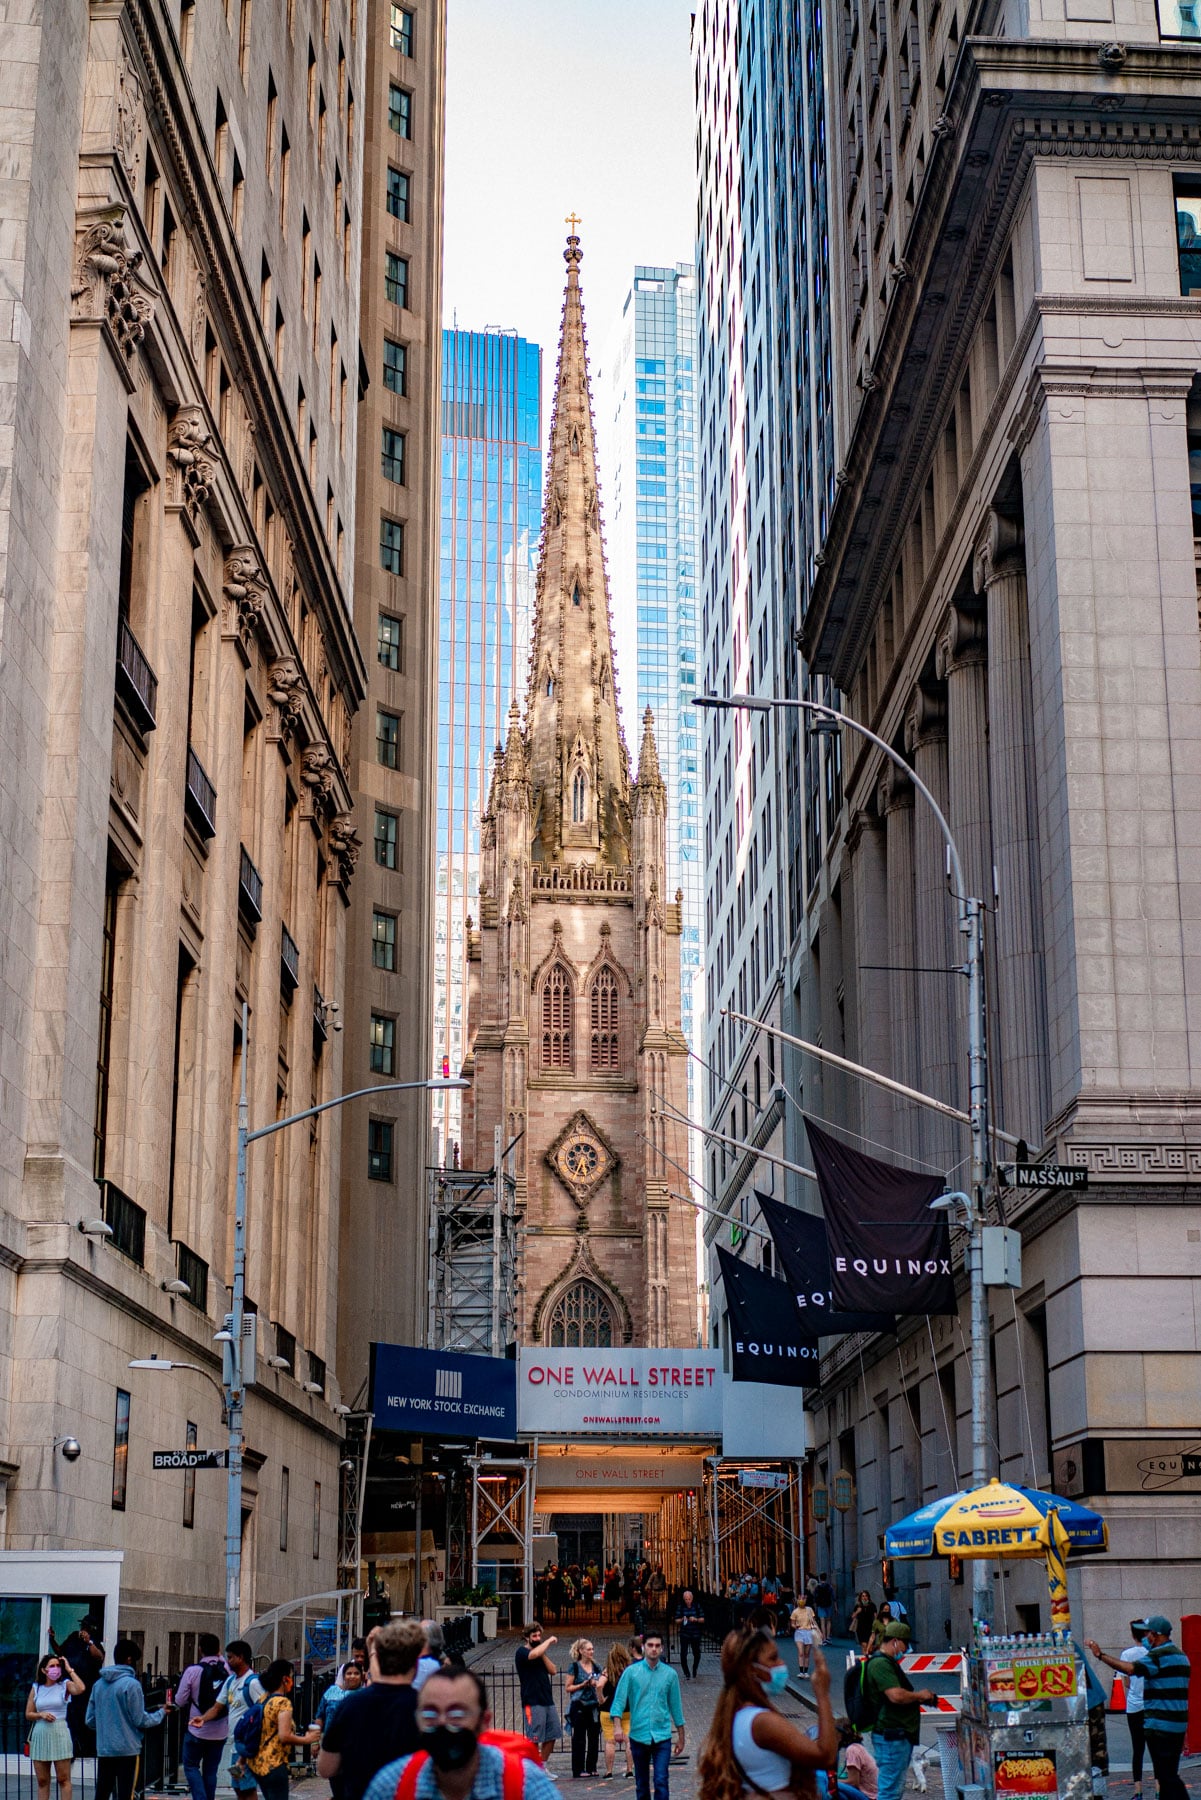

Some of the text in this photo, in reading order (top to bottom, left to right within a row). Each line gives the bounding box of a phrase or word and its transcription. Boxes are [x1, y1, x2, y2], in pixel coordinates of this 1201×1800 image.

[1019, 1169, 1085, 1186] NASSAU ST
[836, 1257, 951, 1276] EQUINOX
[736, 1342, 818, 1360] EQUINOX
[528, 1366, 716, 1386] ONE WALL STREET
[553, 1389, 689, 1399] CONDOMINIUM RESIDENCES
[387, 1395, 505, 1418] NEW YORK STOCK EXCHANGE
[583, 1416, 661, 1424] ONEWALLSTREET.COM
[154, 1455, 198, 1467] BROAD
[1149, 1461, 1201, 1470] EQUIN
[575, 1469, 665, 1479] ONE WALL STREET
[942, 1526, 1040, 1547] SABRETT
[1015, 1656, 1071, 1668] CHEESE PRETZEL
